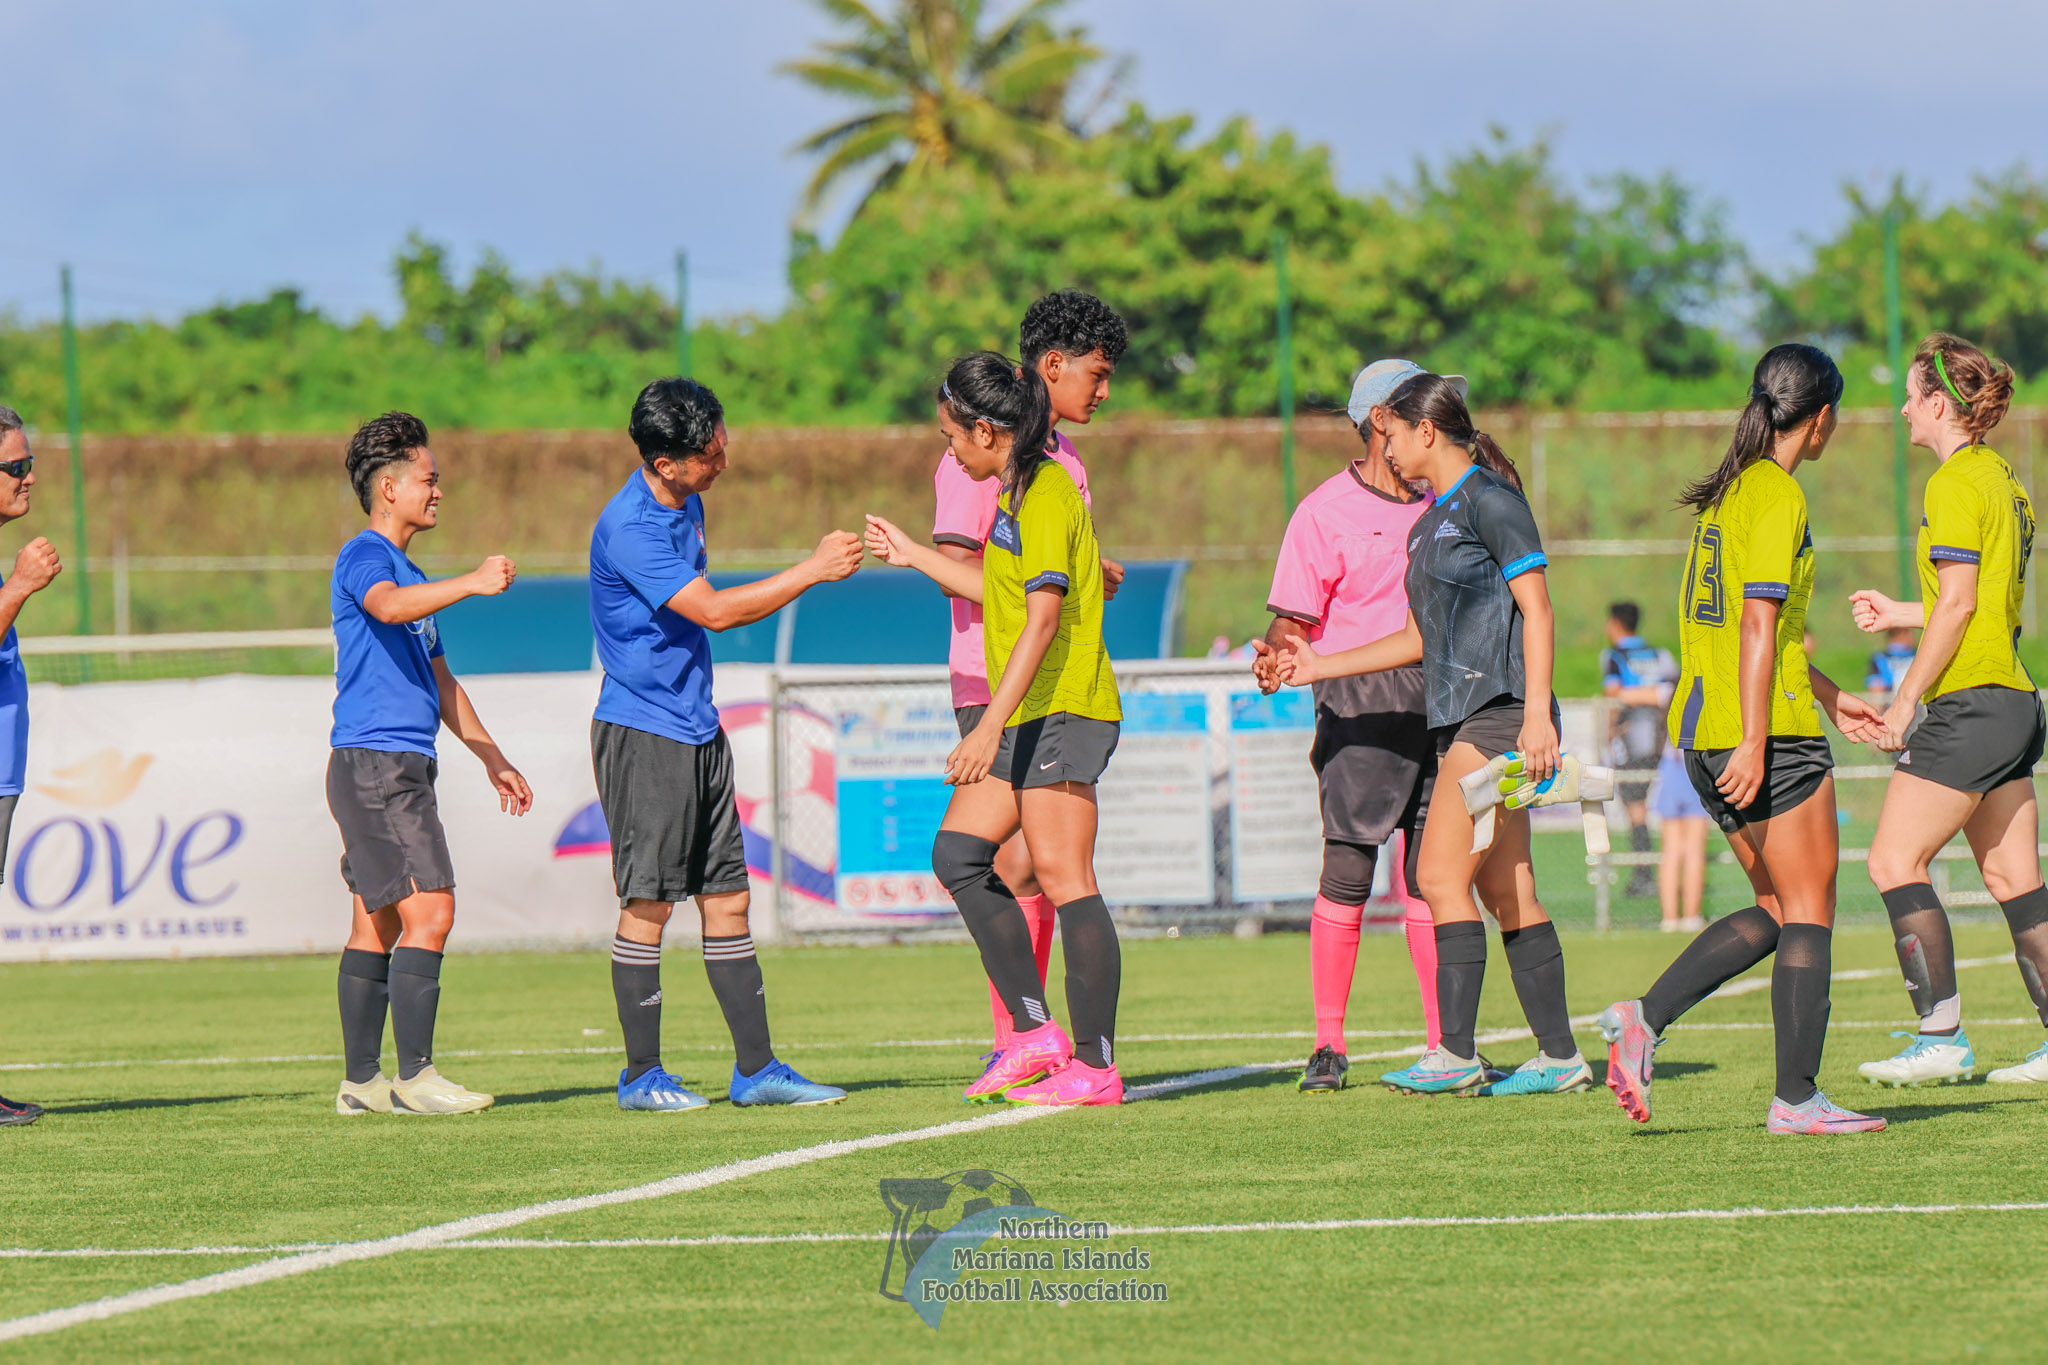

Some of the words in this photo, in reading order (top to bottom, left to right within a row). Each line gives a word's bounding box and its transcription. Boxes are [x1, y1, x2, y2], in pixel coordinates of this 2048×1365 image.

[1685, 520, 1727, 628] 13
[12, 811, 244, 913] ove
[3, 919, 128, 942] WOMEN'S
[141, 917, 247, 938] LEAGUE
